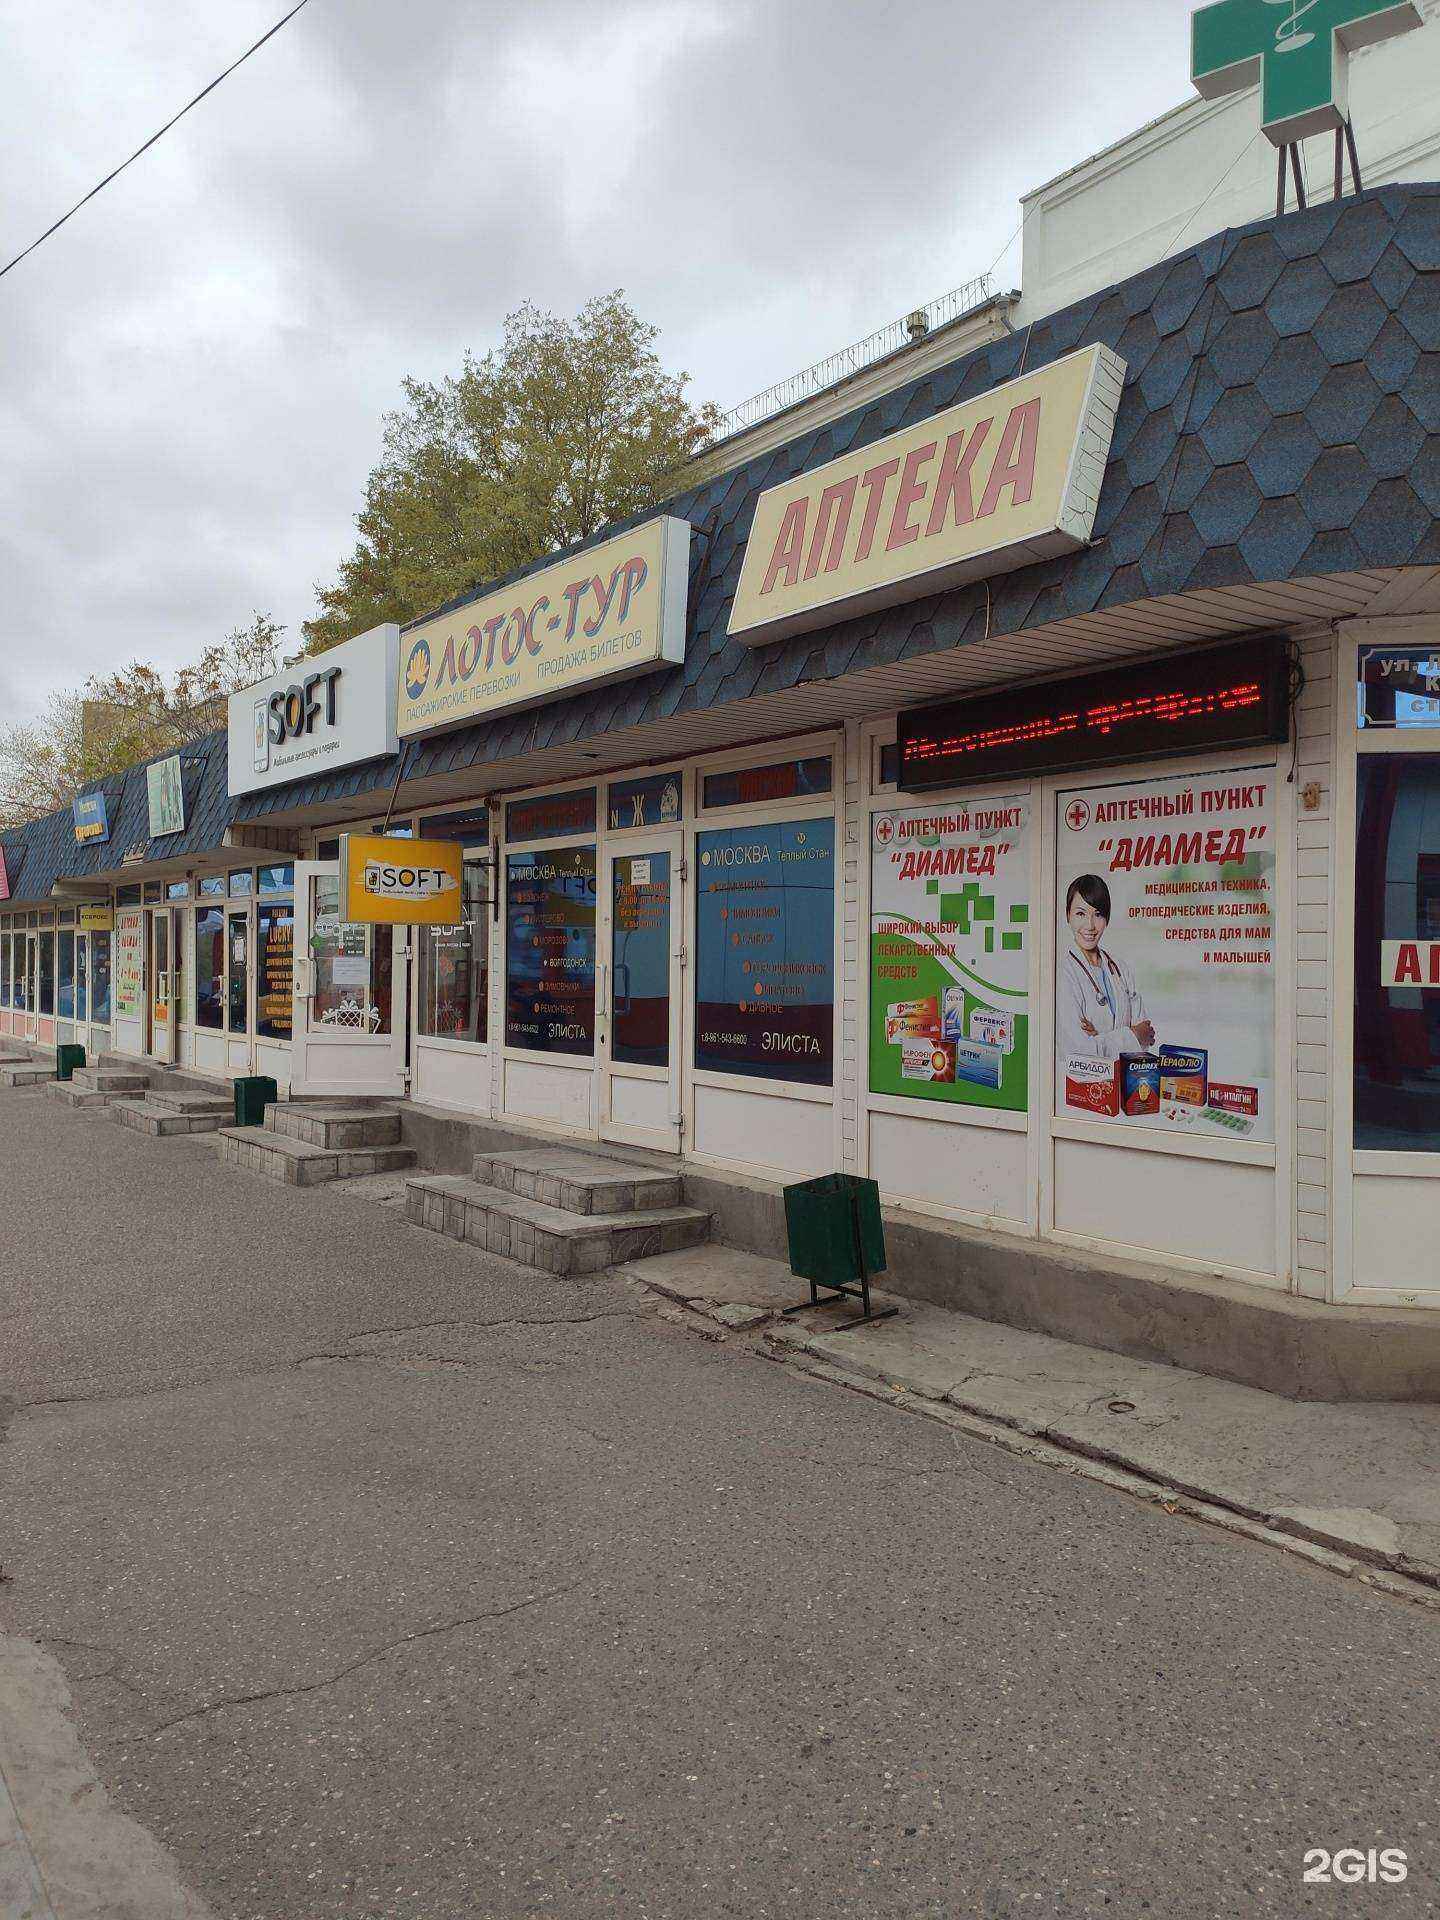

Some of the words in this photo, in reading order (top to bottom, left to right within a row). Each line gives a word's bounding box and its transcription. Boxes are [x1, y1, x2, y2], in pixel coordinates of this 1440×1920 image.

[759, 396, 1041, 595] АПТЕКА
[434, 556, 649, 691] ЛОТОС-ТУР
[406, 689, 468, 722] ПАССАЖИРСКИЕ
[469, 672, 521, 700] ПЕРЕВОЗКИ
[537, 650, 588, 680] ПРОДАЖА
[590, 629, 642, 664] БИЛЕТОВ
[267, 666, 342, 745] SOFT
[1095, 788, 1194, 824] АПТЕЧНЫЙ
[1200, 784, 1267, 813] ПУНКТ
[898, 809, 970, 838] АПТЕЧНЫЙ
[974, 808, 1022, 831] ПУНКТ
[714, 844, 771, 867] МОСКВА
[809, 848, 830, 859] Стан
[1098, 825, 1267, 872] "ДИАМЕД"
[890, 843, 1010, 881] "ДИАМЕД"
[382, 868, 447, 889] SOFT
[517, 865, 557, 881] МОСКВА
[1145, 879, 1218, 896] МЕДИЦИНСКАЯ
[1128, 904, 1214, 919] ОРТОПЕДИЧЕСКИЕ
[878, 920, 922, 935] ШИРОКИЙ
[925, 922, 959, 935] ВЫБОР
[1165, 927, 1216, 942] СРЕДСТВА
[1219, 928, 1242, 941] ДЛЯ
[1244, 927, 1271, 939] МАМ
[877, 943, 957, 957] ЛЕКАРСТВЕННЫХ
[1203, 952, 1210, 963] И
[1213, 949, 1271, 964] МАЛЫШЕЙ
[549, 957, 588, 969] ВОЛГОДОНСК
[877, 965, 918, 980] СРЕДСТВ
[548, 1022, 586, 1040] ЭЛИСТА
[761, 1031, 821, 1054] ЭЛИСТА
[1069, 1060, 1111, 1074] АРБИДОЛ
